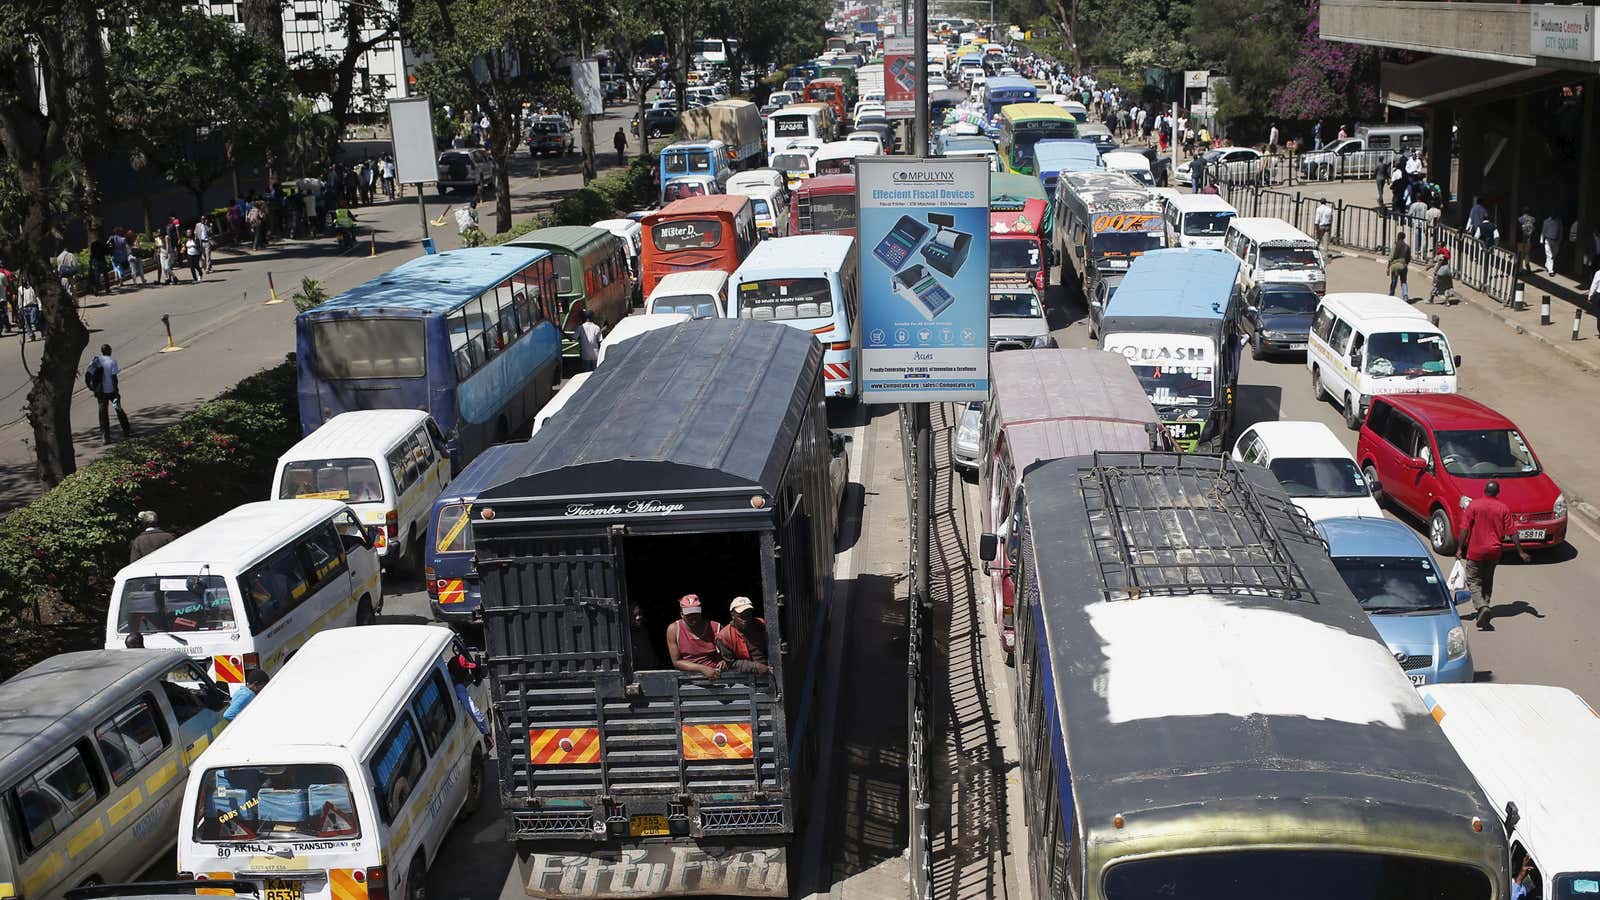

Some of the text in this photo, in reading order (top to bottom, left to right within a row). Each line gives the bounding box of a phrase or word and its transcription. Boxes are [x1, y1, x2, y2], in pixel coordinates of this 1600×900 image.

[1094, 214, 1148, 233] 007
[564, 499, 685, 516] Tuombe Mungu
